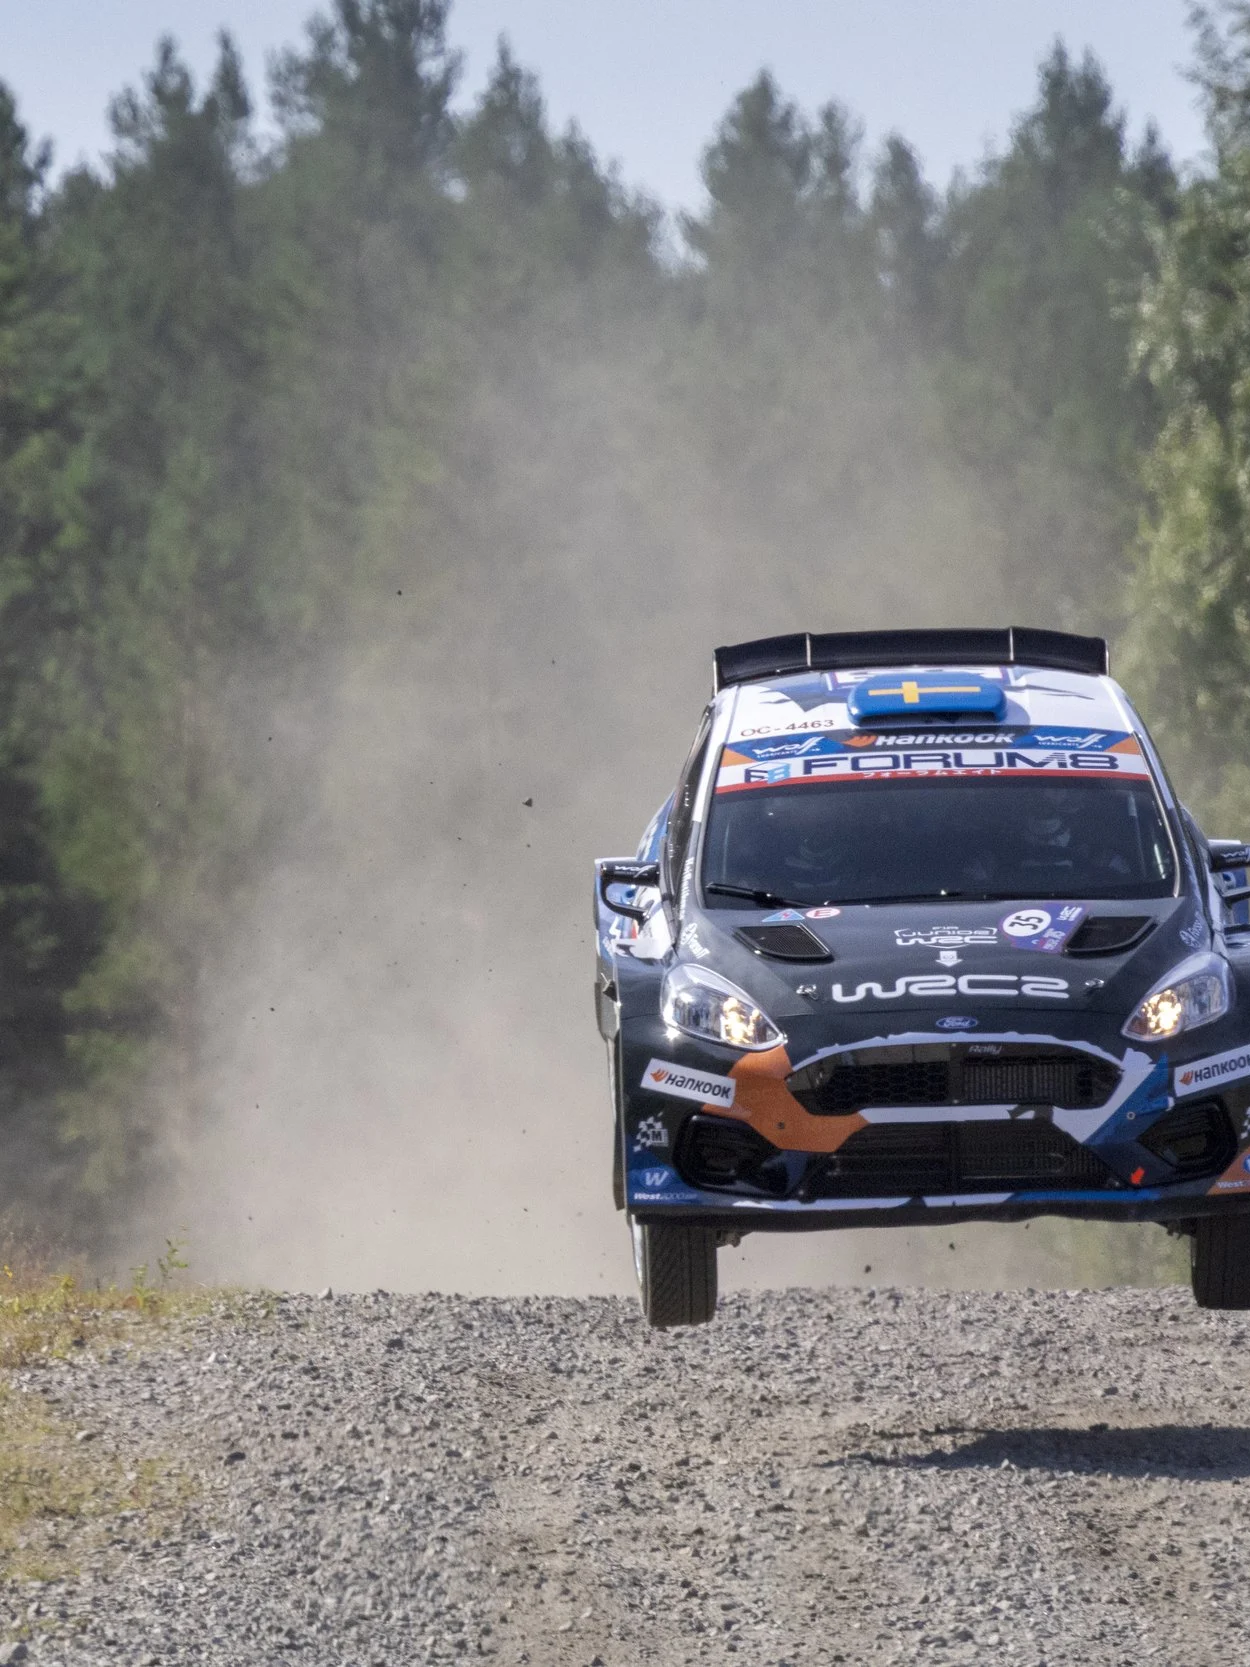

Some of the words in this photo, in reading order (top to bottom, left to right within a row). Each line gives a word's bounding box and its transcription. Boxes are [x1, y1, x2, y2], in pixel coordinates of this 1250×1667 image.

[803, 752, 1119, 775] FORUM8
[1008, 915, 1044, 930] 35
[896, 935, 998, 945] WRC
[832, 974, 1070, 1003] WRC2
